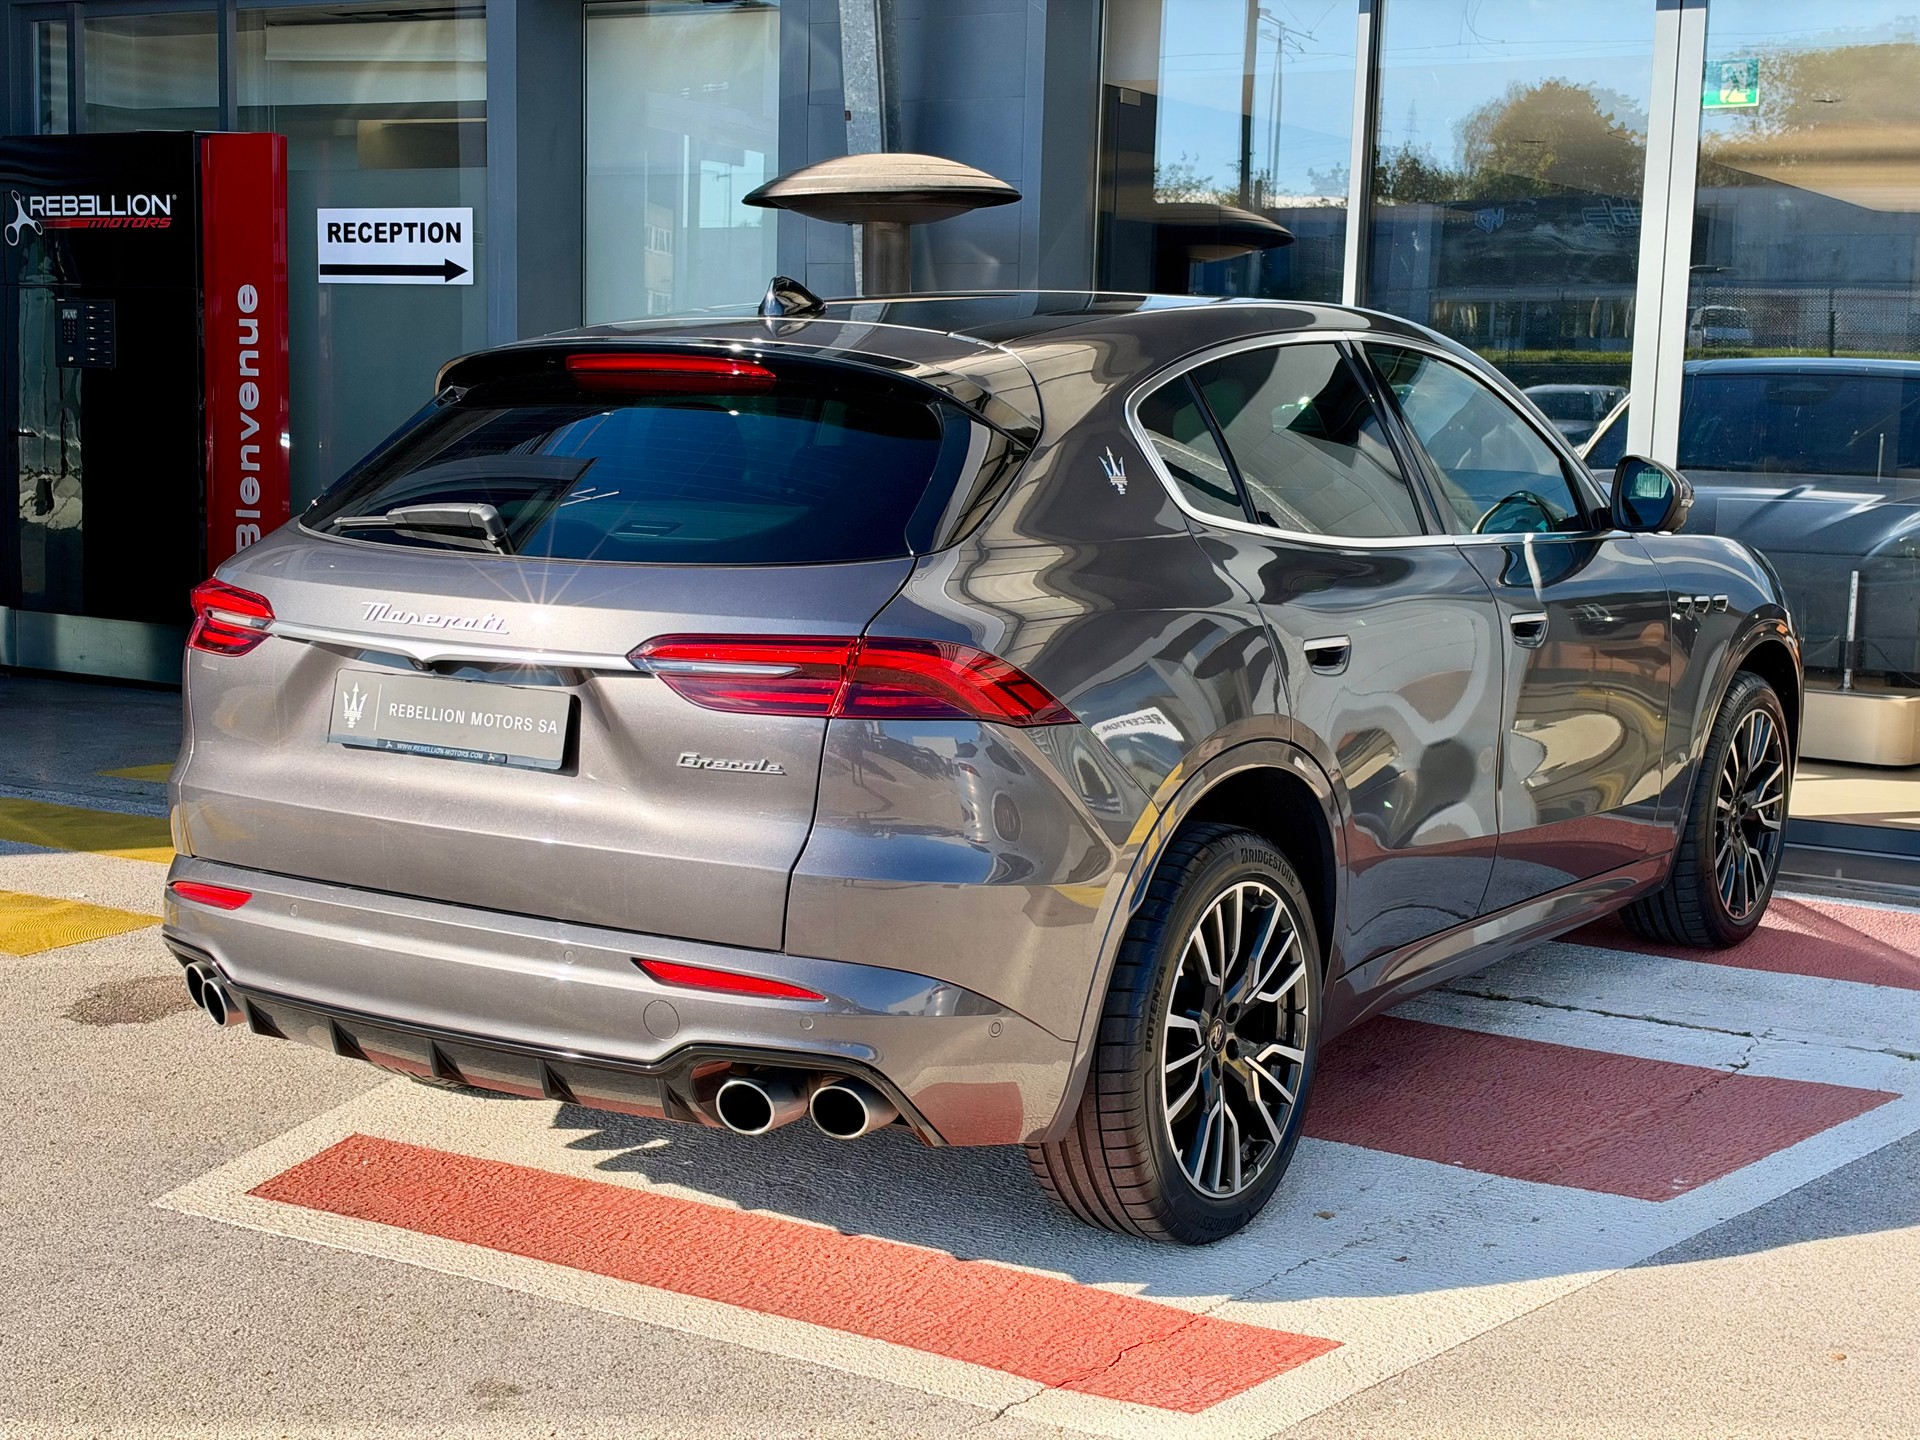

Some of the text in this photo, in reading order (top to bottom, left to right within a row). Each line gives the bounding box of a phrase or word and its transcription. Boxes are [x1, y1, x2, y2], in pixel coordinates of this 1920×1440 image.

[89, 217, 172, 229] MOTORS
[327, 222, 462, 243] RECEPTION
[236, 284, 260, 553] Bienvenue
[361, 601, 510, 635] Maserati
[389, 702, 558, 735] REBELLION MOTORS SA
[396, 743, 484, 760] WWW.REBELLION-MOTORS.COM
[676, 751, 787, 776] Grecale
[1240, 847, 1296, 888] BRIDGESTONE
[1145, 966, 1166, 1052] POTENZA
